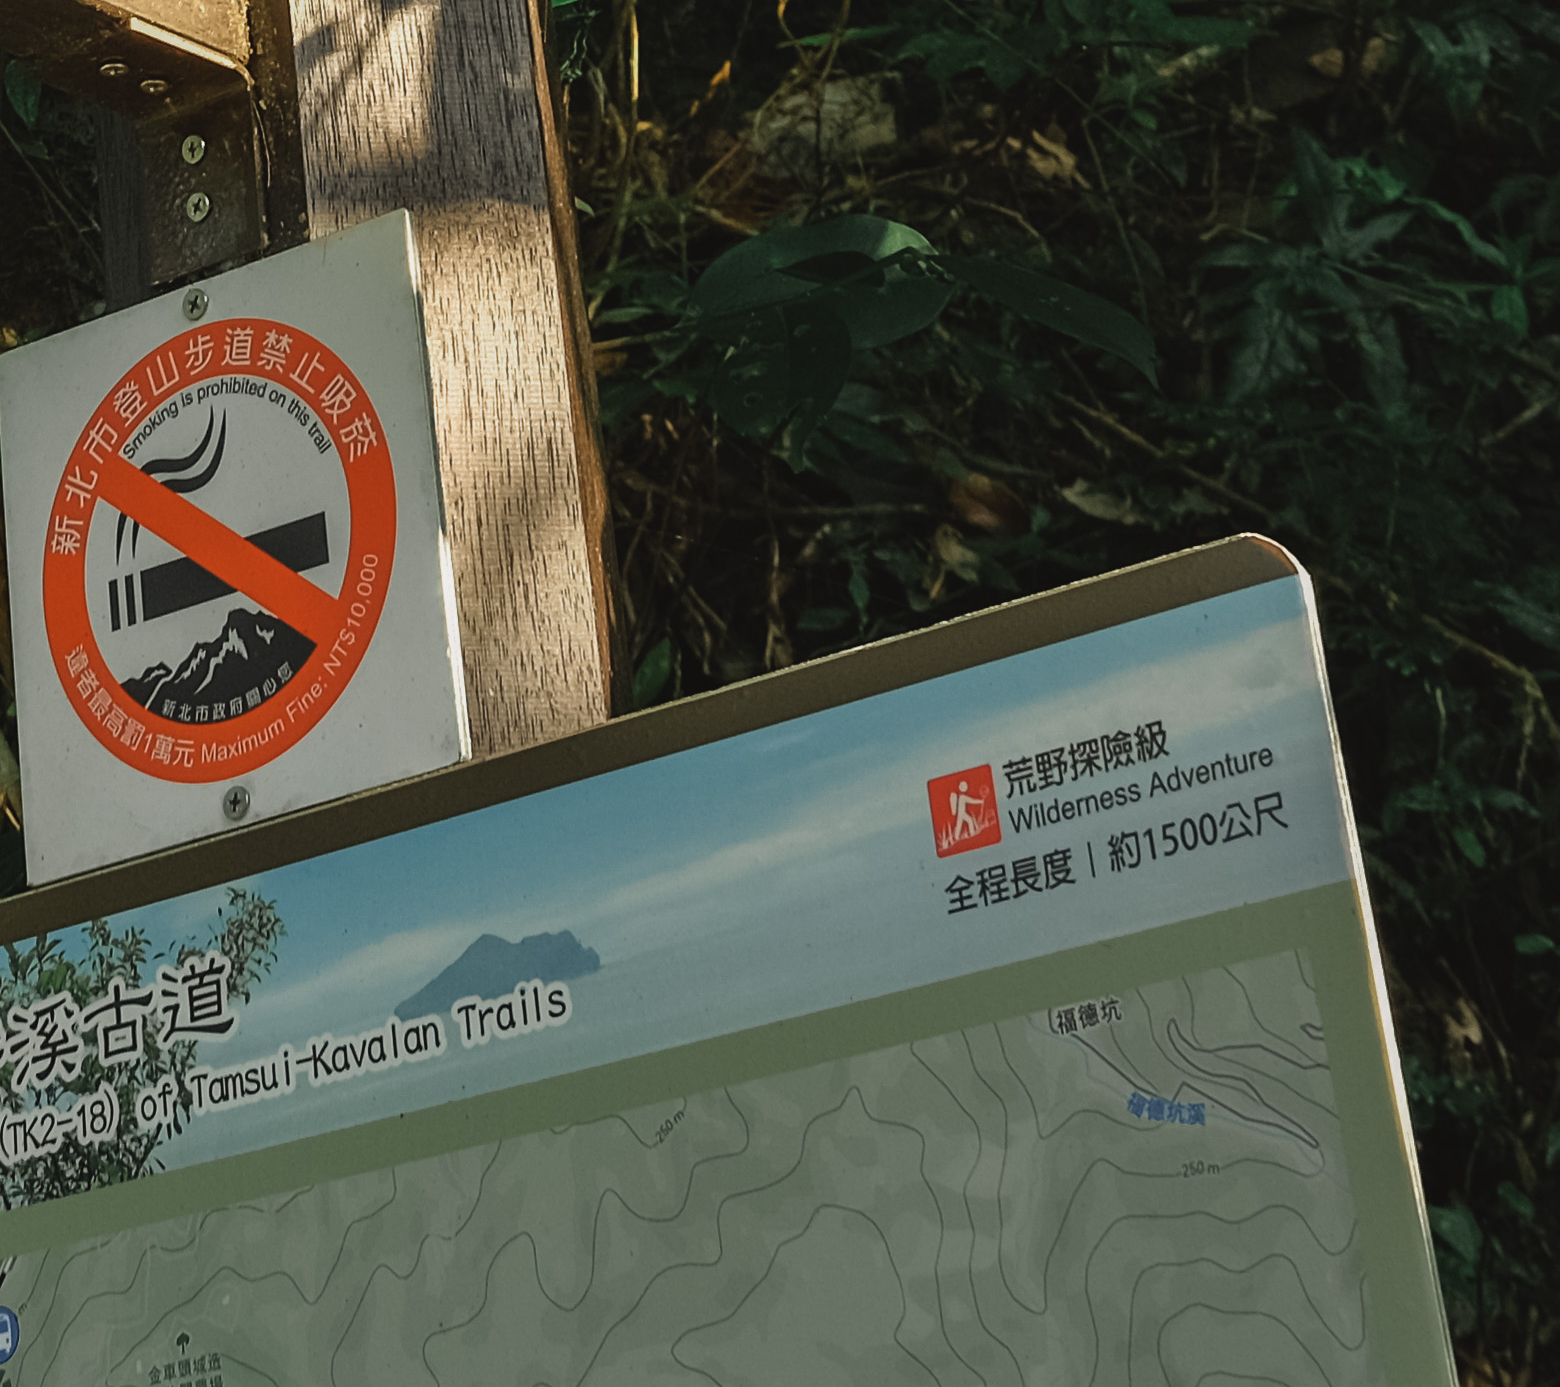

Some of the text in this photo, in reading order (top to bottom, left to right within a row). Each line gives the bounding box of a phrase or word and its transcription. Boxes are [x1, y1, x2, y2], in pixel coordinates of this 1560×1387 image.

[51, 325, 378, 557] 新北市登山步道禁止吸菸
[123, 376, 333, 460] Smoking is prohibited on this trail
[200, 553, 379, 765] Maximum Fine: NT$10,000
[1001, 719, 1171, 800] 荒野探險級
[1008, 746, 1275, 835] Wilderness Adventure
[944, 791, 1290, 916] 全程長度 約1500公尺
[140, 1085, 174, 1124] of
[190, 1018, 442, 1104] Tamsui-Kavalan
[456, 985, 569, 1043] Trails
